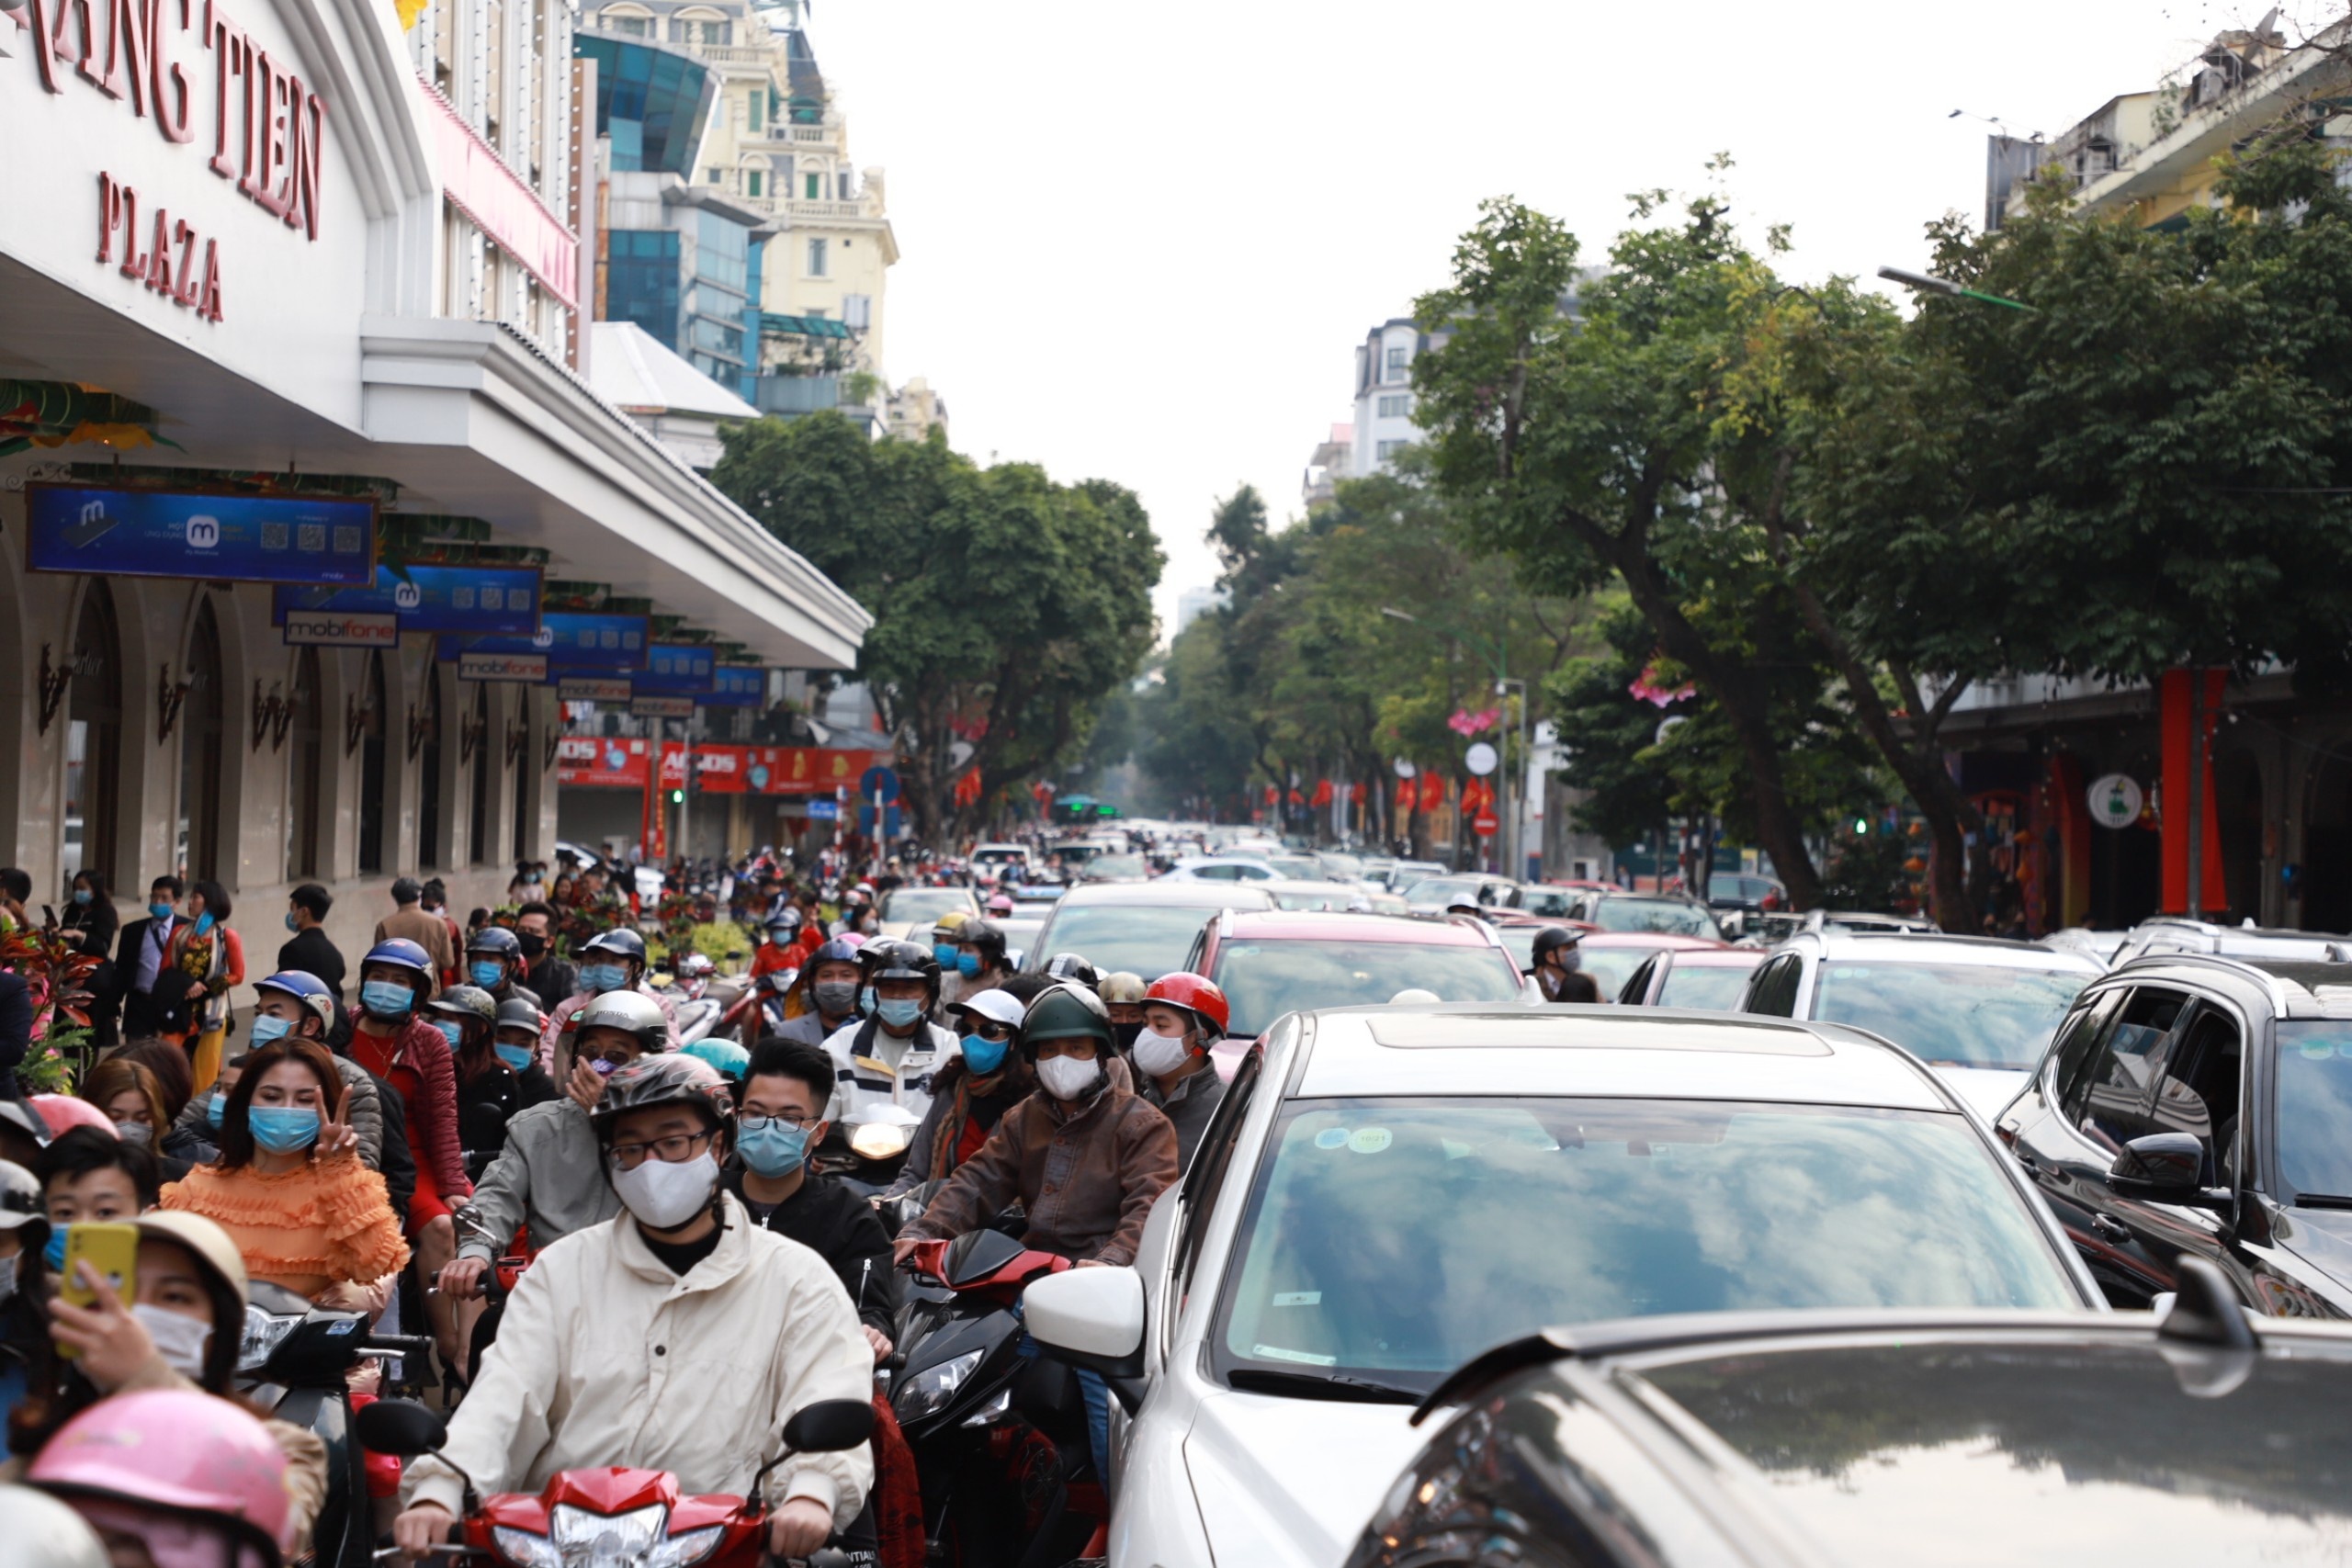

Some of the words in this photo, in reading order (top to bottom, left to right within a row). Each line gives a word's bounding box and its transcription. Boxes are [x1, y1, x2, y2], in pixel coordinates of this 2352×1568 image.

[204, 0, 328, 242] TIEN
[96, 171, 223, 322] PLAZA
[288, 618, 395, 638] mobifone
[460, 659, 546, 676] mobifone
[560, 681, 631, 696] mobifone
[596, 1010, 629, 1019] HONDA
